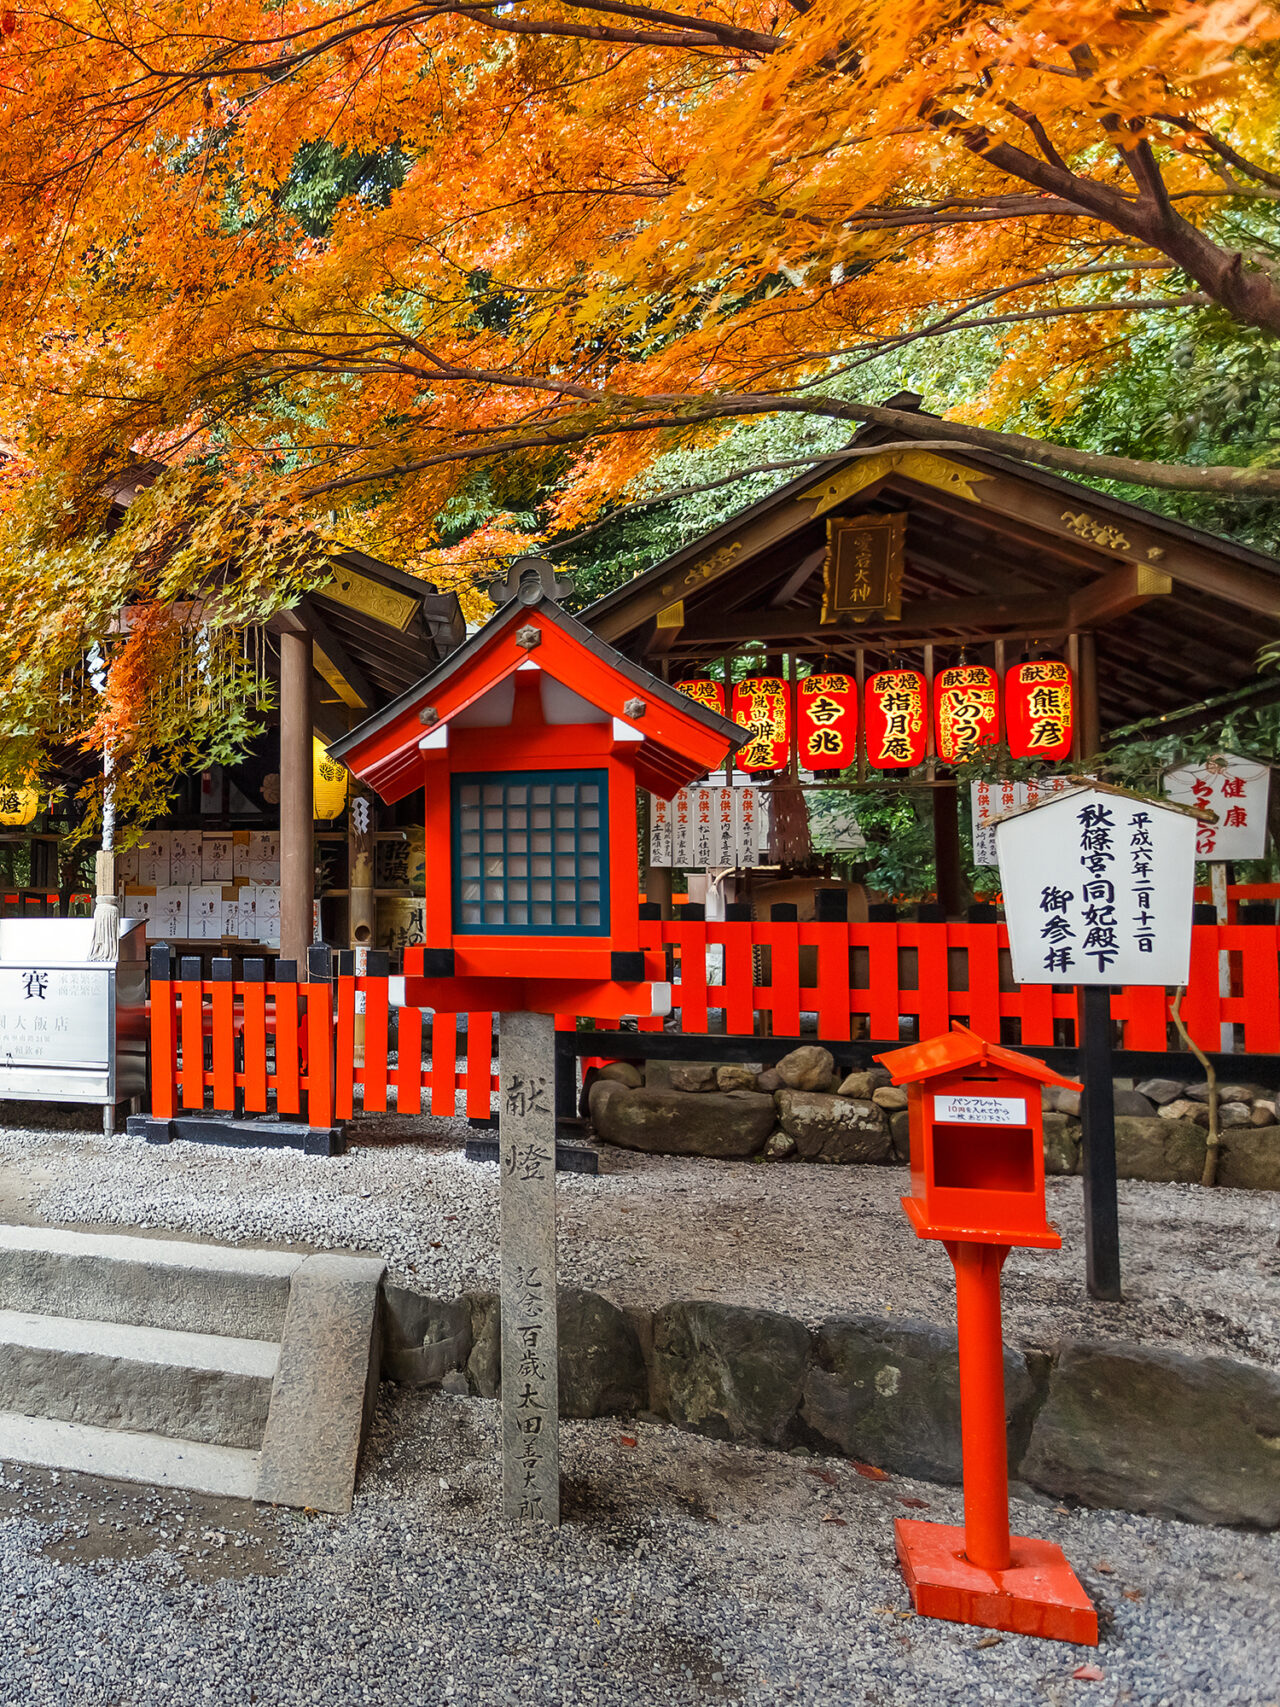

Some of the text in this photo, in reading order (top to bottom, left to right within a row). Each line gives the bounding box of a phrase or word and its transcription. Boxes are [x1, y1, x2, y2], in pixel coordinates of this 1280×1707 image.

[740, 679, 783, 696] 献燈
[804, 676, 848, 692] 献燈
[876, 674, 918, 691] 献燈
[944, 669, 989, 685] 献燈
[1022, 665, 1067, 681] 献燈
[880, 694, 913, 759] 指月庵
[1030, 688, 1062, 746] 熊彦
[677, 790, 688, 823] お供え
[699, 789, 710, 823] お供え
[720, 789, 731, 823] お供え
[742, 788, 754, 823] お供え
[977, 782, 989, 818] お供え
[1221, 777, 1247, 827] 健康
[1076, 803, 1119, 973] 秋篠宮・同妃殿下
[1128, 812, 1156, 952] 平成六年二月十二日
[1040, 886, 1076, 973] 御参拝
[952, 1098, 1002, 1106] パンフレット
[505, 1075, 552, 1180] 献燈
